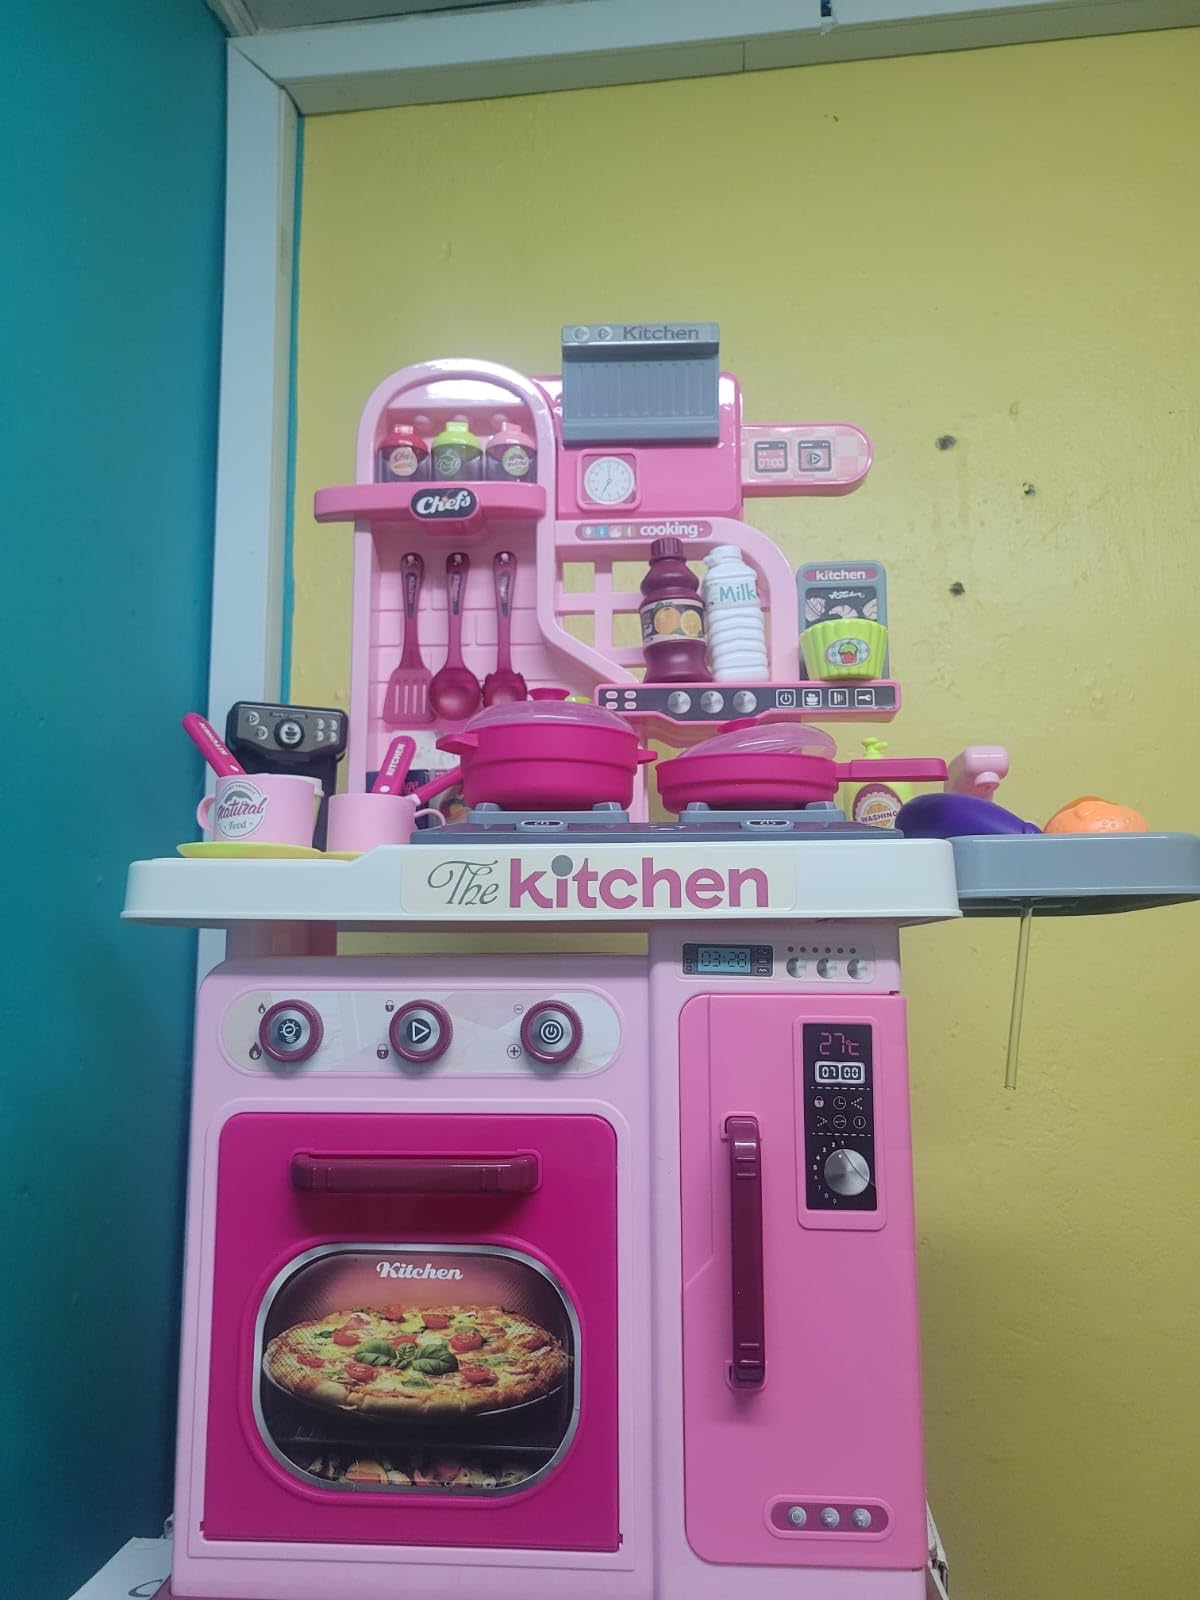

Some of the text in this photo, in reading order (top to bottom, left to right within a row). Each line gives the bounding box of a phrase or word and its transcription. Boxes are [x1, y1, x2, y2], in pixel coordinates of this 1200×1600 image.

[623, 326, 699, 340] Kitchen
[639, 521, 699, 538] cooking
[815, 569, 866, 581] kitchen
[719, 583, 756, 602] Milk
[385, 743, 406, 776] KITCHEN
[427, 854, 769, 909] The kitchen
[376, 1261, 464, 1280] Kitchen
